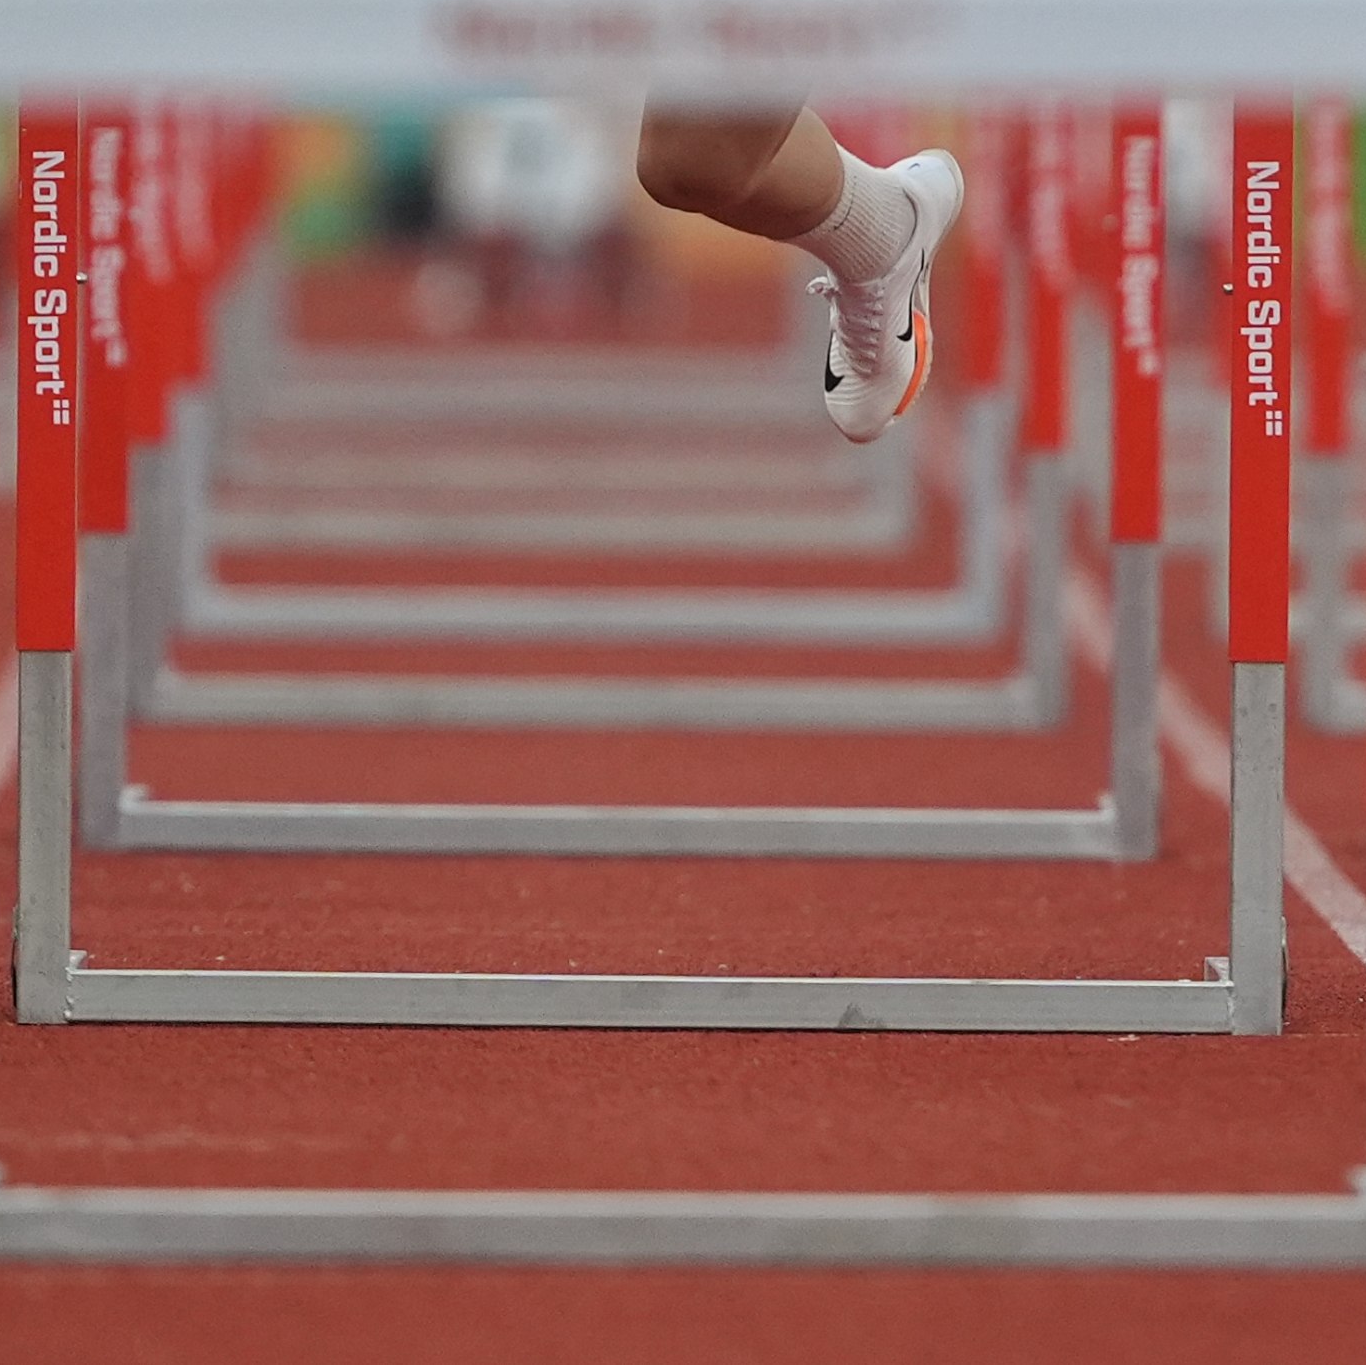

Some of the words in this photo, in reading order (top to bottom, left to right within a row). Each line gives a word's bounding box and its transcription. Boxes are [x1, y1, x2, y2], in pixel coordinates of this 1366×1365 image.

[31, 150, 68, 278] Nordic
[1246, 161, 1282, 289] Nordic
[27, 288, 68, 396] Sport
[1239, 299, 1282, 407] Sport
